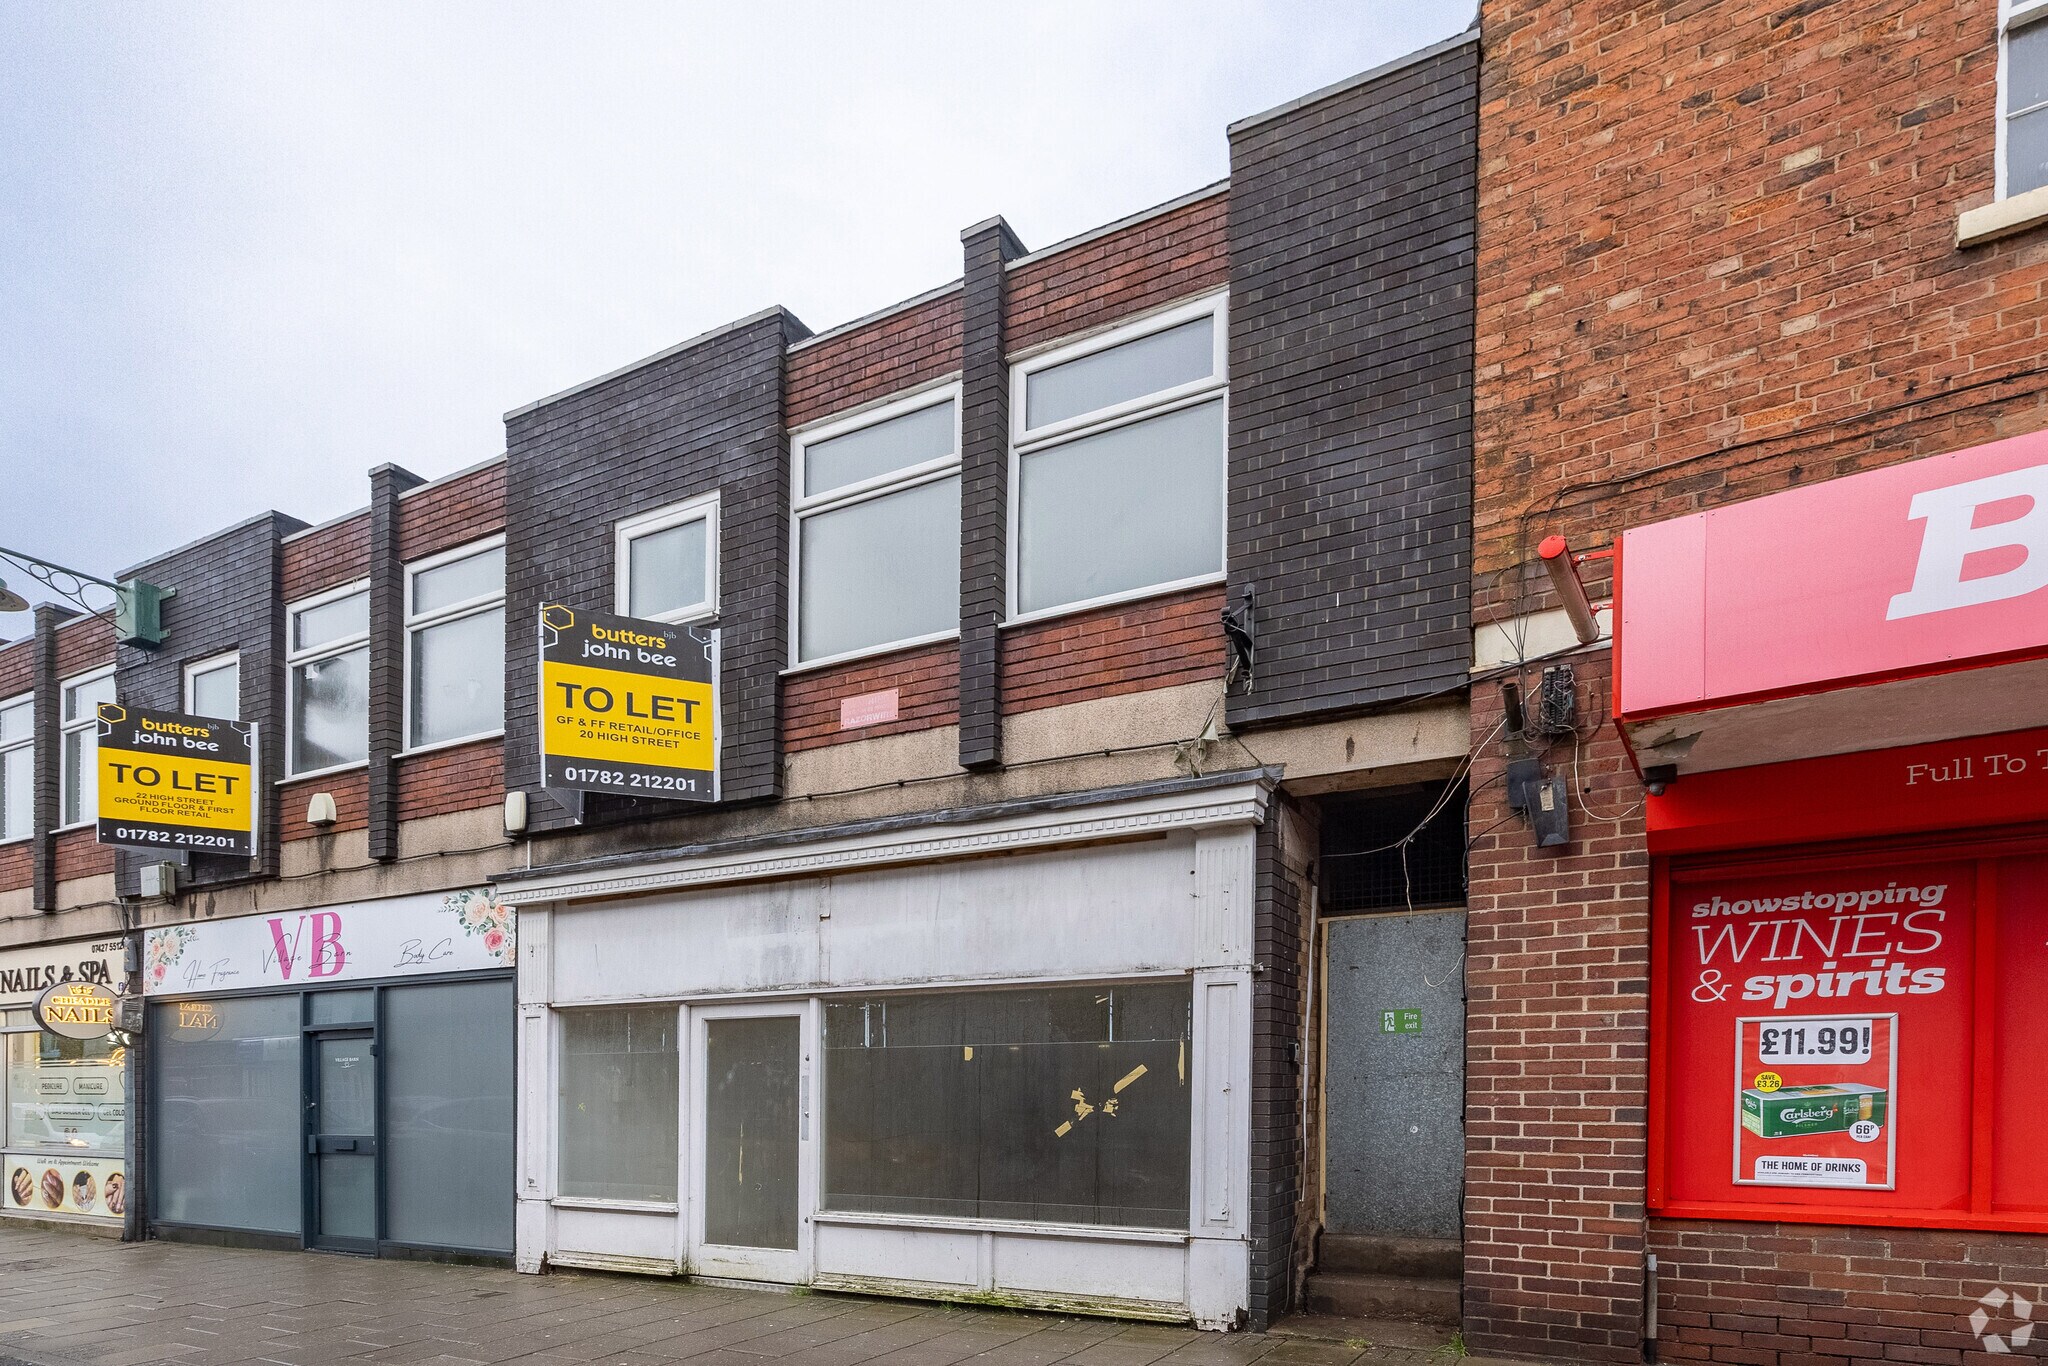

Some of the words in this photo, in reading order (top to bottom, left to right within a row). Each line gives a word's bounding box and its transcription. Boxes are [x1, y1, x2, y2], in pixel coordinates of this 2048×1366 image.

[591, 623, 667, 649] butters
[663, 630, 677, 640] bjb
[581, 639, 631, 661] john
[637, 648, 677, 667] bee
[556, 681, 614, 713] TO
[626, 691, 701, 724] LET
[141, 718, 210, 738] butters
[207, 723, 220, 731] bjb
[556, 715, 574, 725] GF
[578, 718, 587, 728] &
[591, 720, 605, 729] FF
[609, 722, 701, 740] RETAIL/OFFICE
[579, 729, 594, 739] 20
[597, 733, 628, 743] HIGH
[632, 737, 680, 749] STREET
[132, 730, 177, 747] john
[183, 736, 219, 752] bee
[108, 762, 161, 787] TO
[172, 770, 240, 795] LET
[565, 766, 625, 786] 01782
[629, 772, 696, 792] 212201
[1906, 757, 1974, 785] Full
[1983, 753, 2027, 776] To
[114, 796, 159, 807] GROUND
[161, 801, 195, 811] FLOOR
[198, 804, 206, 812] &
[207, 805, 236, 815] FIRST
[139, 806, 175, 815] FLOOR
[177, 809, 212, 819] RETAIL
[149, 794, 175, 802] HIGH
[176, 796, 215, 806] STREET
[116, 827, 171, 843] 01782
[174, 832, 236, 848] 212201
[1691, 882, 1948, 918] showstopping
[267, 911, 346, 980] VB
[1691, 909, 1946, 965] WINES
[262, 933, 303, 974] Village
[393, 938, 431, 968] Body
[428, 937, 454, 960] Care
[0, 965, 55, 994] NAILS
[60, 965, 74, 982] &
[78, 959, 113, 985] SPA
[209, 957, 240, 986] Fragrance
[1691, 969, 1732, 1003] &
[1741, 959, 1946, 1009] spirits
[43, 1006, 114, 1024] NAILS
[1404, 1012, 1418, 1020] Fire
[1404, 1021, 1418, 1030] exit
[1761, 1027, 1870, 1055] £11.99!
[1757, 1080, 1780, 1088] £3.26
[1780, 1105, 1834, 1124] Carlsberg
[1761, 1160, 1779, 1170] THE
[1781, 1161, 1808, 1171] HOME
[1811, 1162, 1823, 1172] OF
[1825, 1163, 1861, 1173] DRINKS
